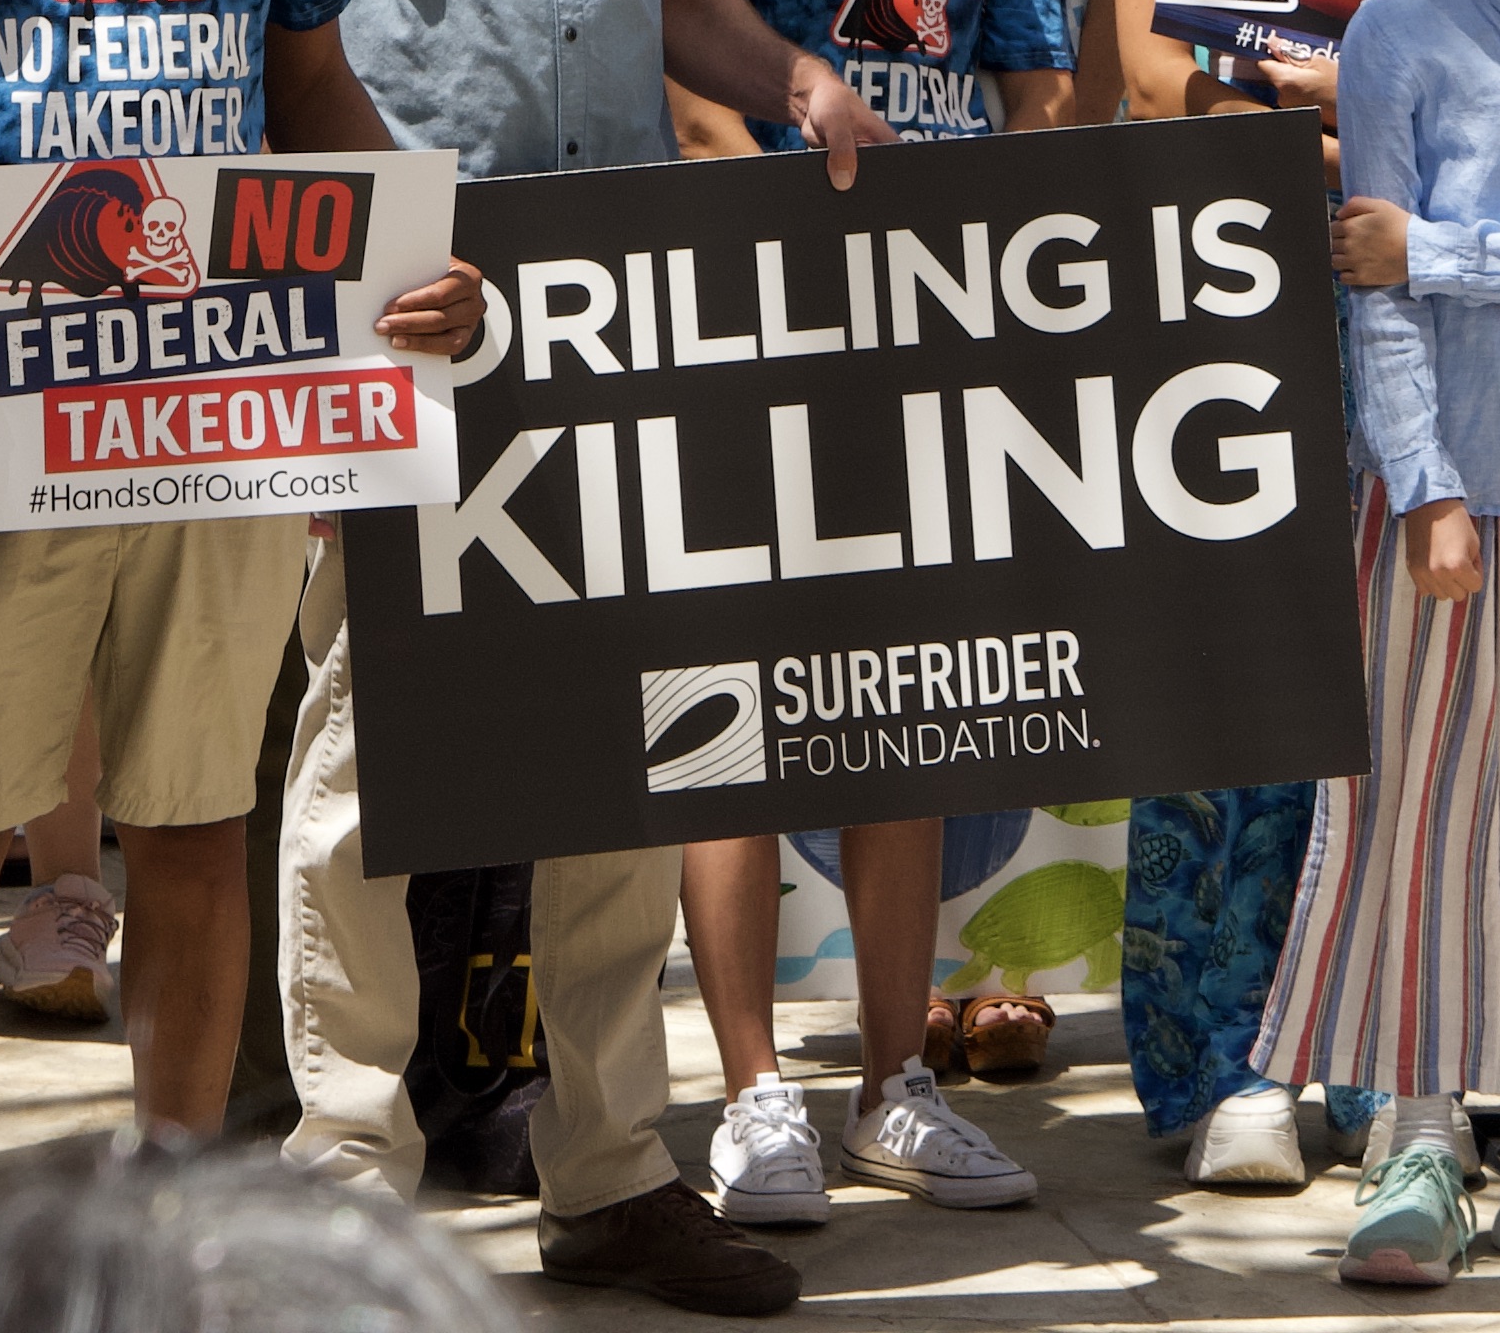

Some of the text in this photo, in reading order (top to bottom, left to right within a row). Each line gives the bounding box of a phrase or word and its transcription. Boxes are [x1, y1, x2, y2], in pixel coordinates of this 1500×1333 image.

[68, 13, 250, 82] FEDERAL
[11, 87, 248, 160] TAKEOVER
[229, 177, 354, 272] NO
[1155, 198, 1281, 322] IS
[6, 286, 326, 388] FEDERAL
[58, 380, 404, 463] TAKEOVER
[30, 468, 359, 514] #HandsOffOurCoast
[418, 362, 1297, 615] KILLING
[774, 630, 1085, 724] SURFRIDER
